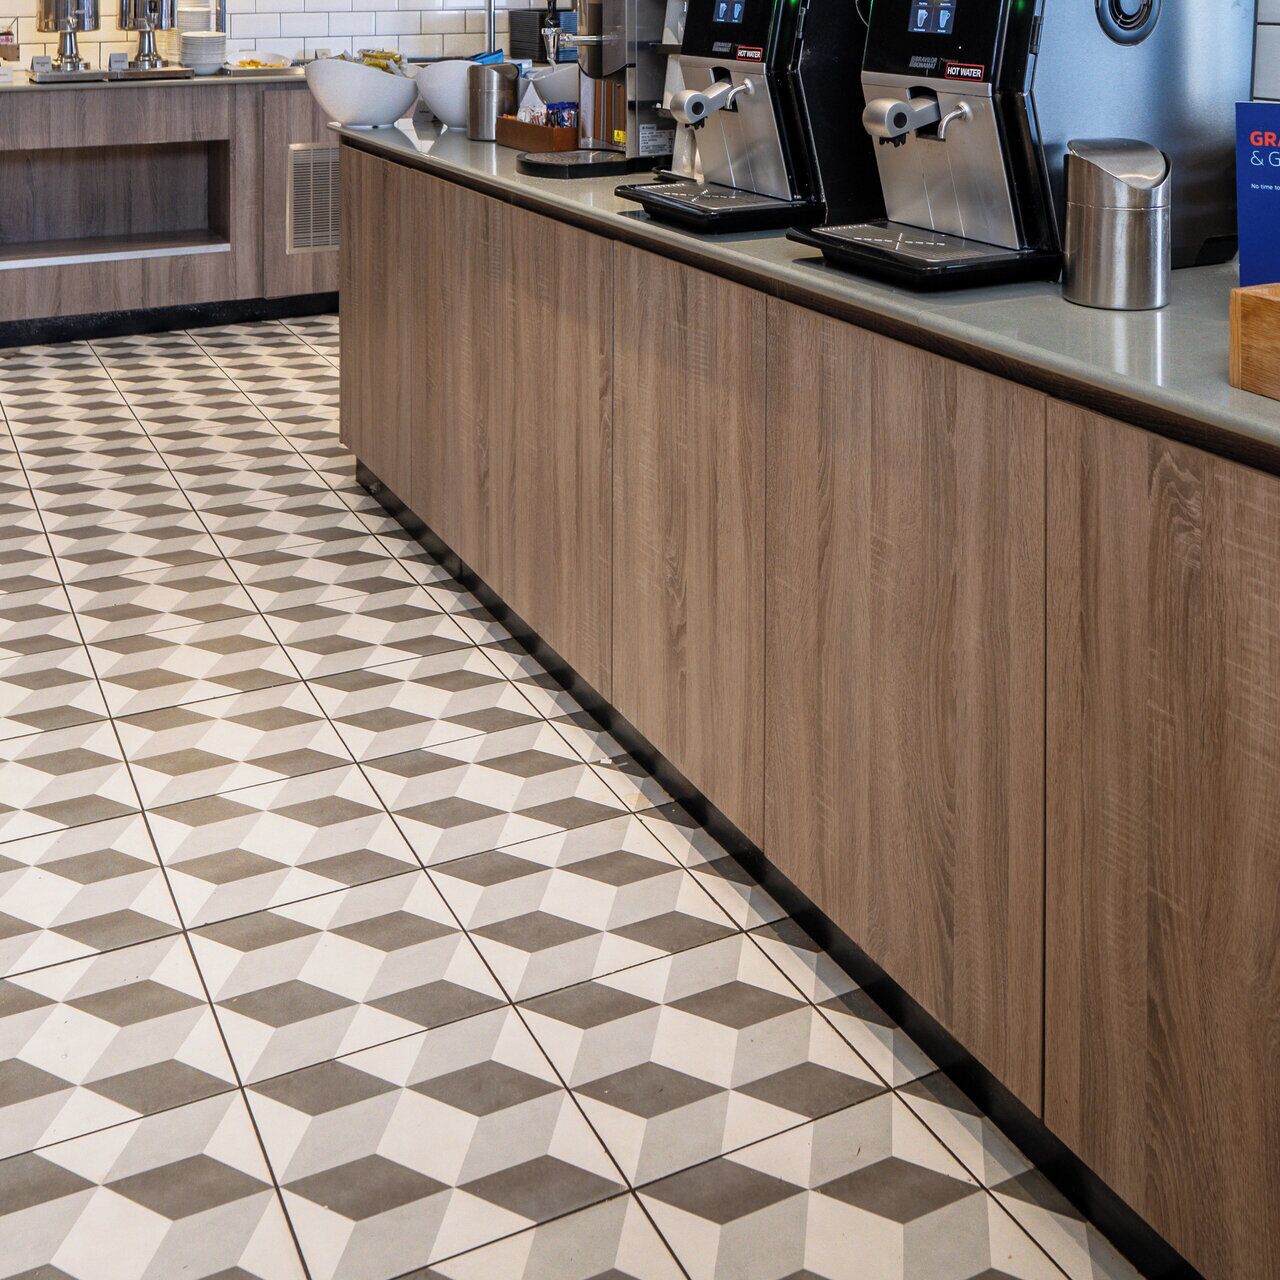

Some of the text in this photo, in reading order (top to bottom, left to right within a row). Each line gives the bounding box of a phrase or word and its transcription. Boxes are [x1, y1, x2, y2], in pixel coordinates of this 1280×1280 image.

[947, 66, 982, 78] HOT WATER
[1250, 150, 1265, 166] &
